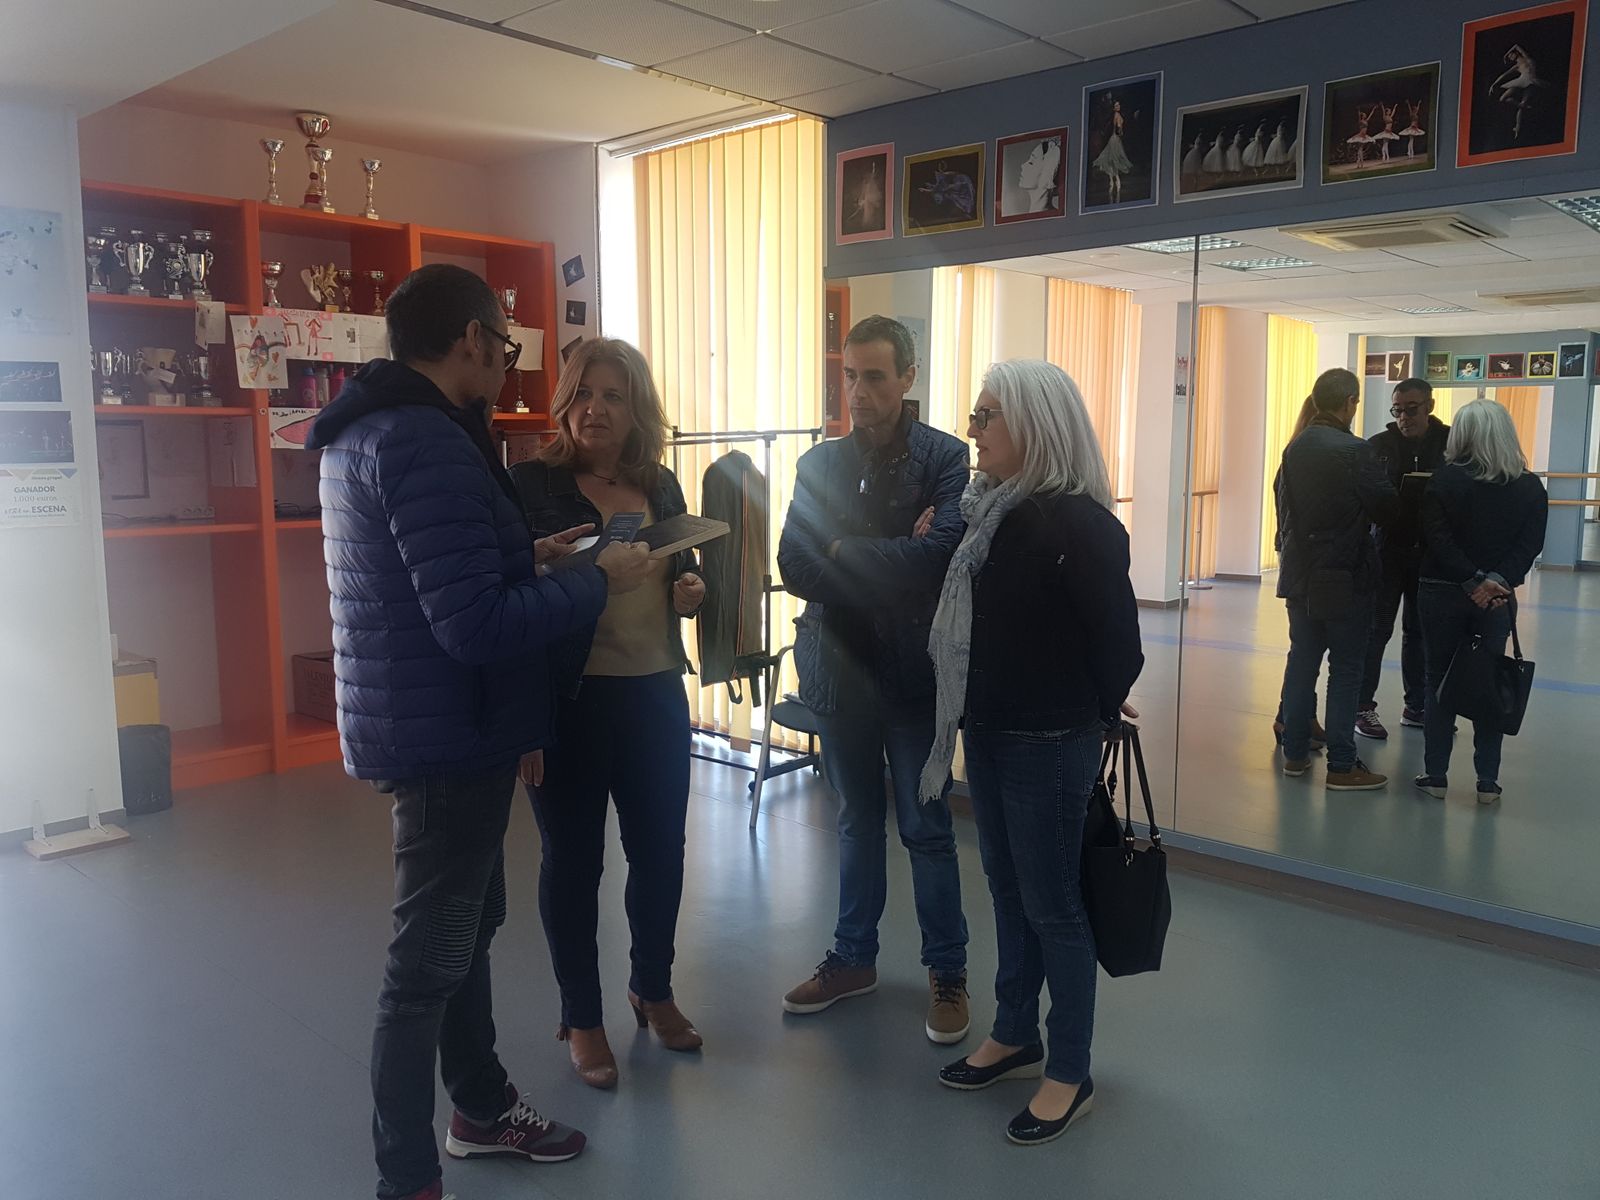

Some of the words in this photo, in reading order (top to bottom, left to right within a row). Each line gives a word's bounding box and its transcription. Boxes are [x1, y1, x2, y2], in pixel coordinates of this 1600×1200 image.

[14, 485, 56, 493] GANADOR
[31, 505, 67, 513] ESCENA
[497, 1129, 525, 1149] N
